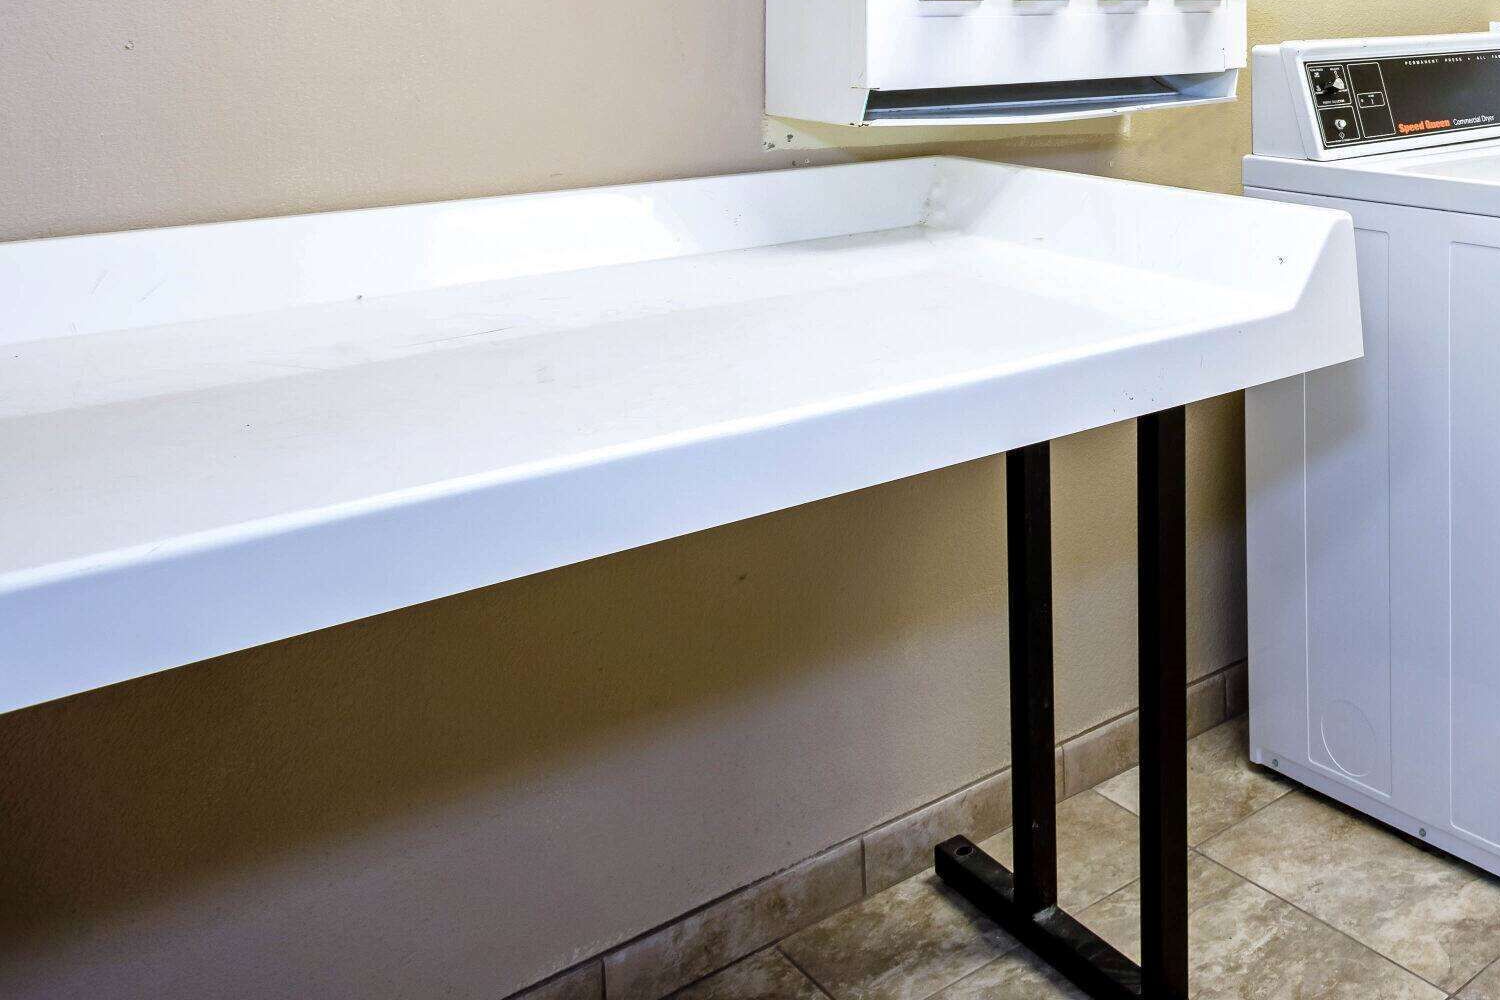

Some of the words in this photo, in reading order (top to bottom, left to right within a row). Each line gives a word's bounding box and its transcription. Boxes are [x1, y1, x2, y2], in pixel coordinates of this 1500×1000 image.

[1404, 58, 1439, 66] PERMANENT
[1398, 121, 1425, 135] Speed
[1426, 118, 1451, 130] Queen
[1452, 115, 1481, 126] Commercial
[1481, 114, 1495, 123] Dryer
